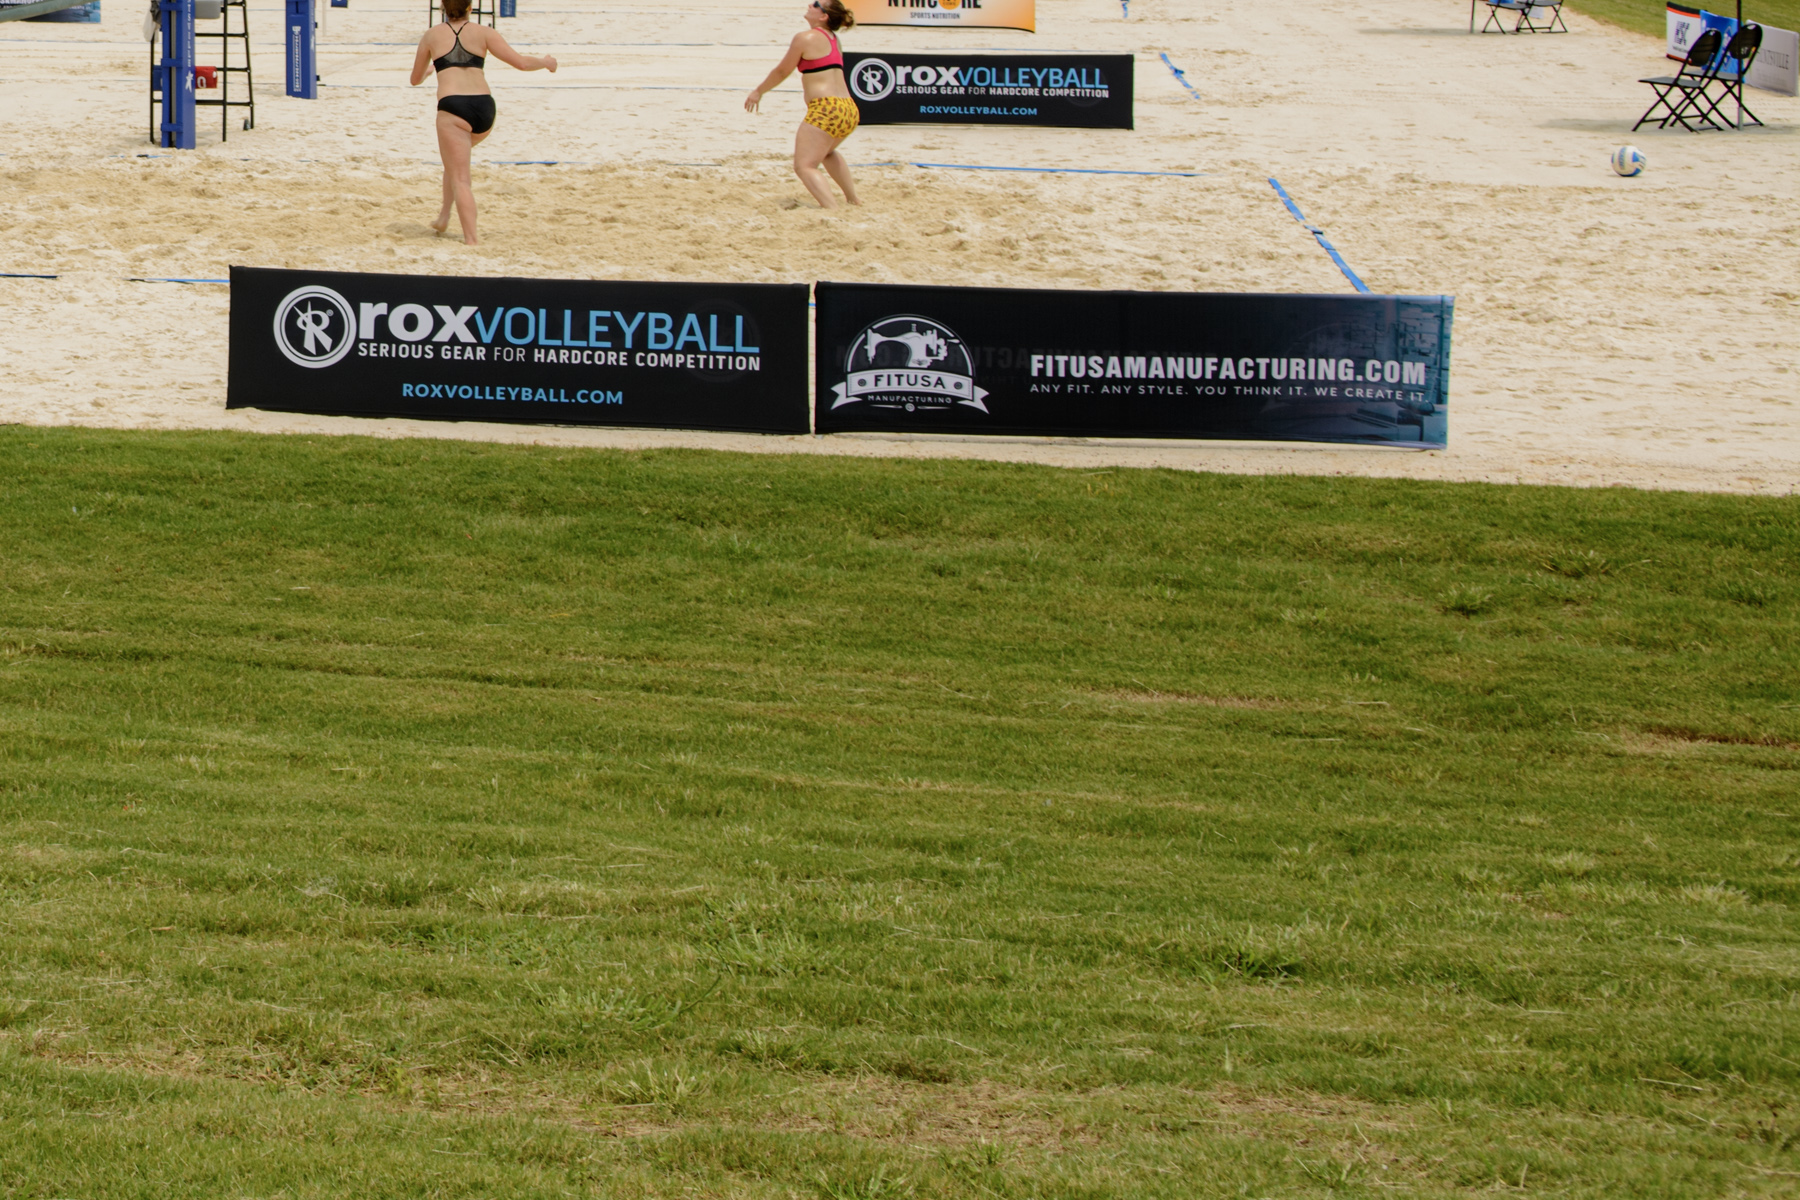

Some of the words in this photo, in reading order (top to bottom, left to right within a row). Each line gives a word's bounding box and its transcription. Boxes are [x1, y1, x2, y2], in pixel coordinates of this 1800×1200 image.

[896, 86, 938, 95] SERIOUS
[940, 86, 965, 95] GEAR
[968, 86, 986, 95] FOR
[989, 87, 1040, 97] HARDCORE
[1043, 88, 1109, 98] COMPETITION
[919, 105, 1038, 116] ROXVOLLEYBALL.COM
[358, 342, 435, 359] SERIOUS
[441, 345, 486, 361] GEAR
[494, 347, 526, 362] FOR
[534, 348, 628, 366] HARDCORE
[635, 352, 760, 371] COMPETITION
[1030, 354, 1426, 386] FITUSAMANUFACTURING.COM
[874, 374, 946, 389] FITUSA
[402, 383, 623, 405] ROXVOLLEYBALL.COM
[868, 395, 952, 404] MANUFACTURING
[1030, 384, 1061, 393] ANY
[1067, 384, 1095, 394] FIT.
[1101, 385, 1132, 394] ANY
[1138, 385, 1188, 395] STYLE.
[1195, 386, 1227, 395] YOU
[1234, 386, 1282, 396] THINK
[1289, 387, 1307, 396] IT.
[1315, 387, 1338, 397] WE
[1345, 388, 1403, 400] CREATE
[1410, 391, 1429, 403] IT.
